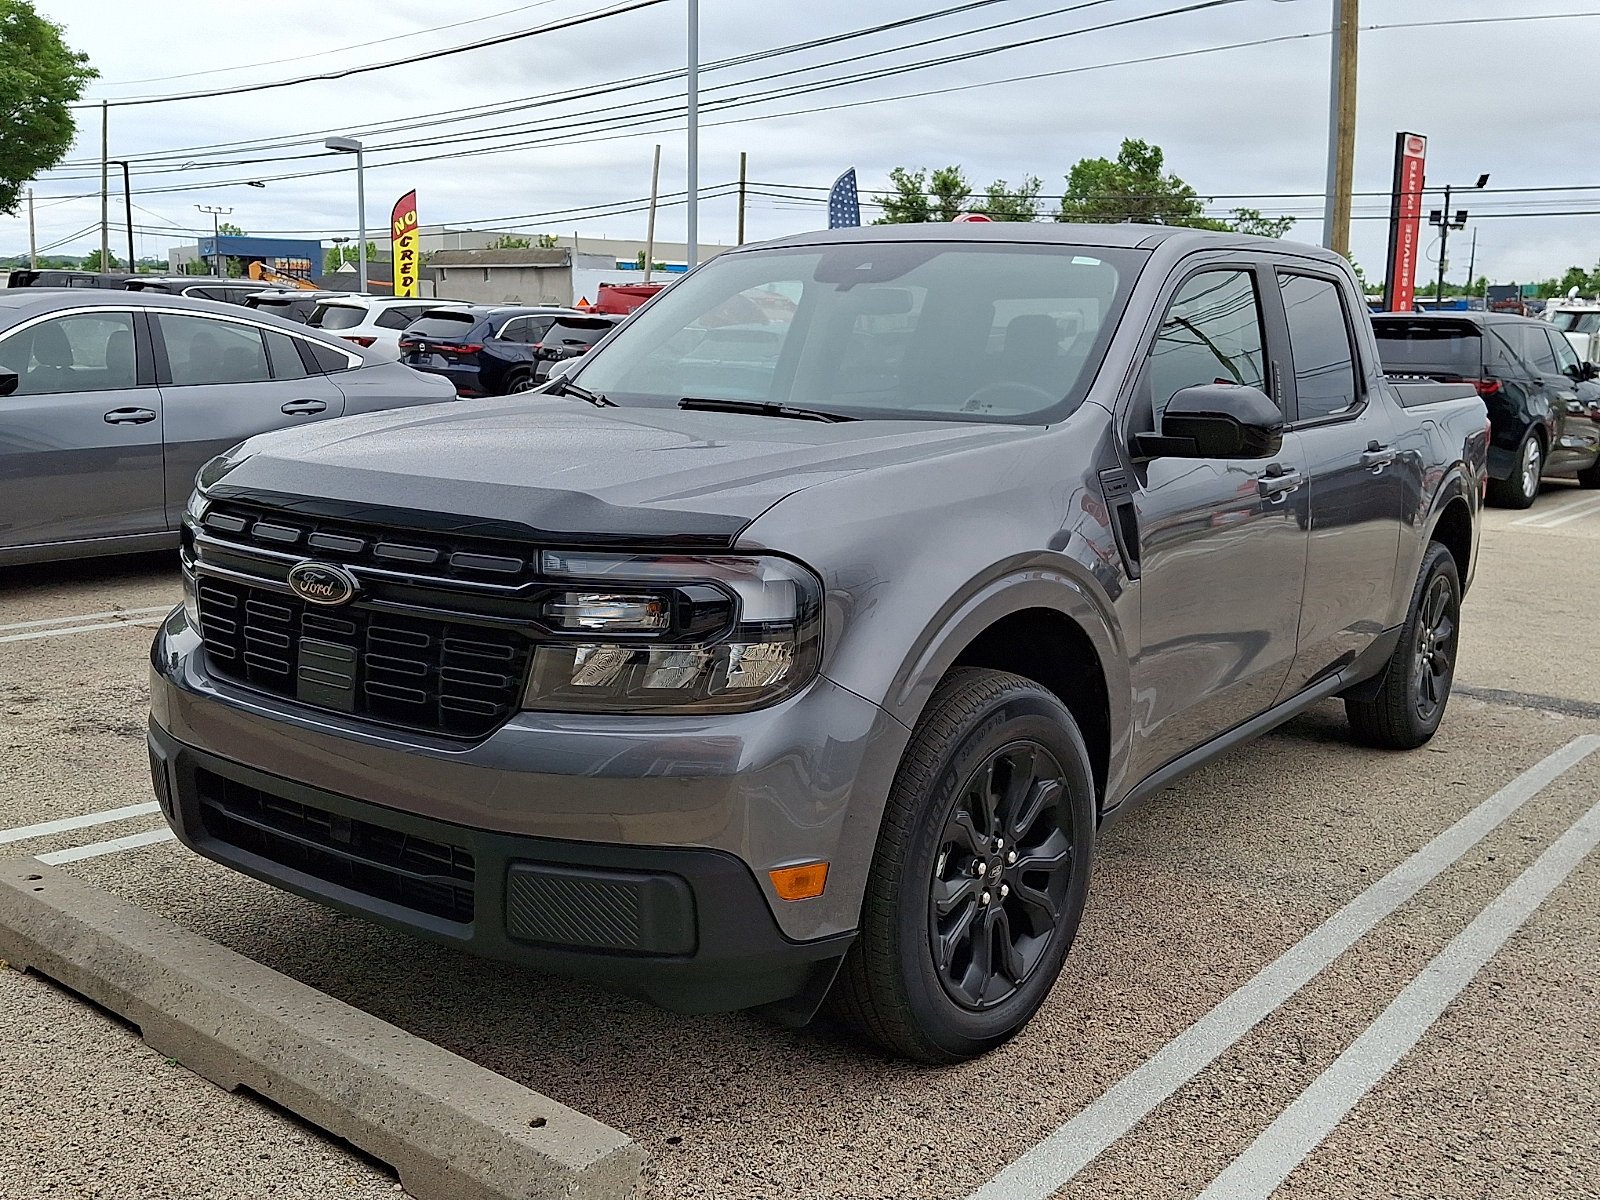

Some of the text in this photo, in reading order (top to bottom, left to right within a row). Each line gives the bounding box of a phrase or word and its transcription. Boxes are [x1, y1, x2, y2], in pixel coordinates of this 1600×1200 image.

[1408, 161, 1418, 210] PARTS
[394, 210, 416, 235] NO
[1401, 224, 1413, 287] SERVICE
[300, 572, 334, 596] Ford
